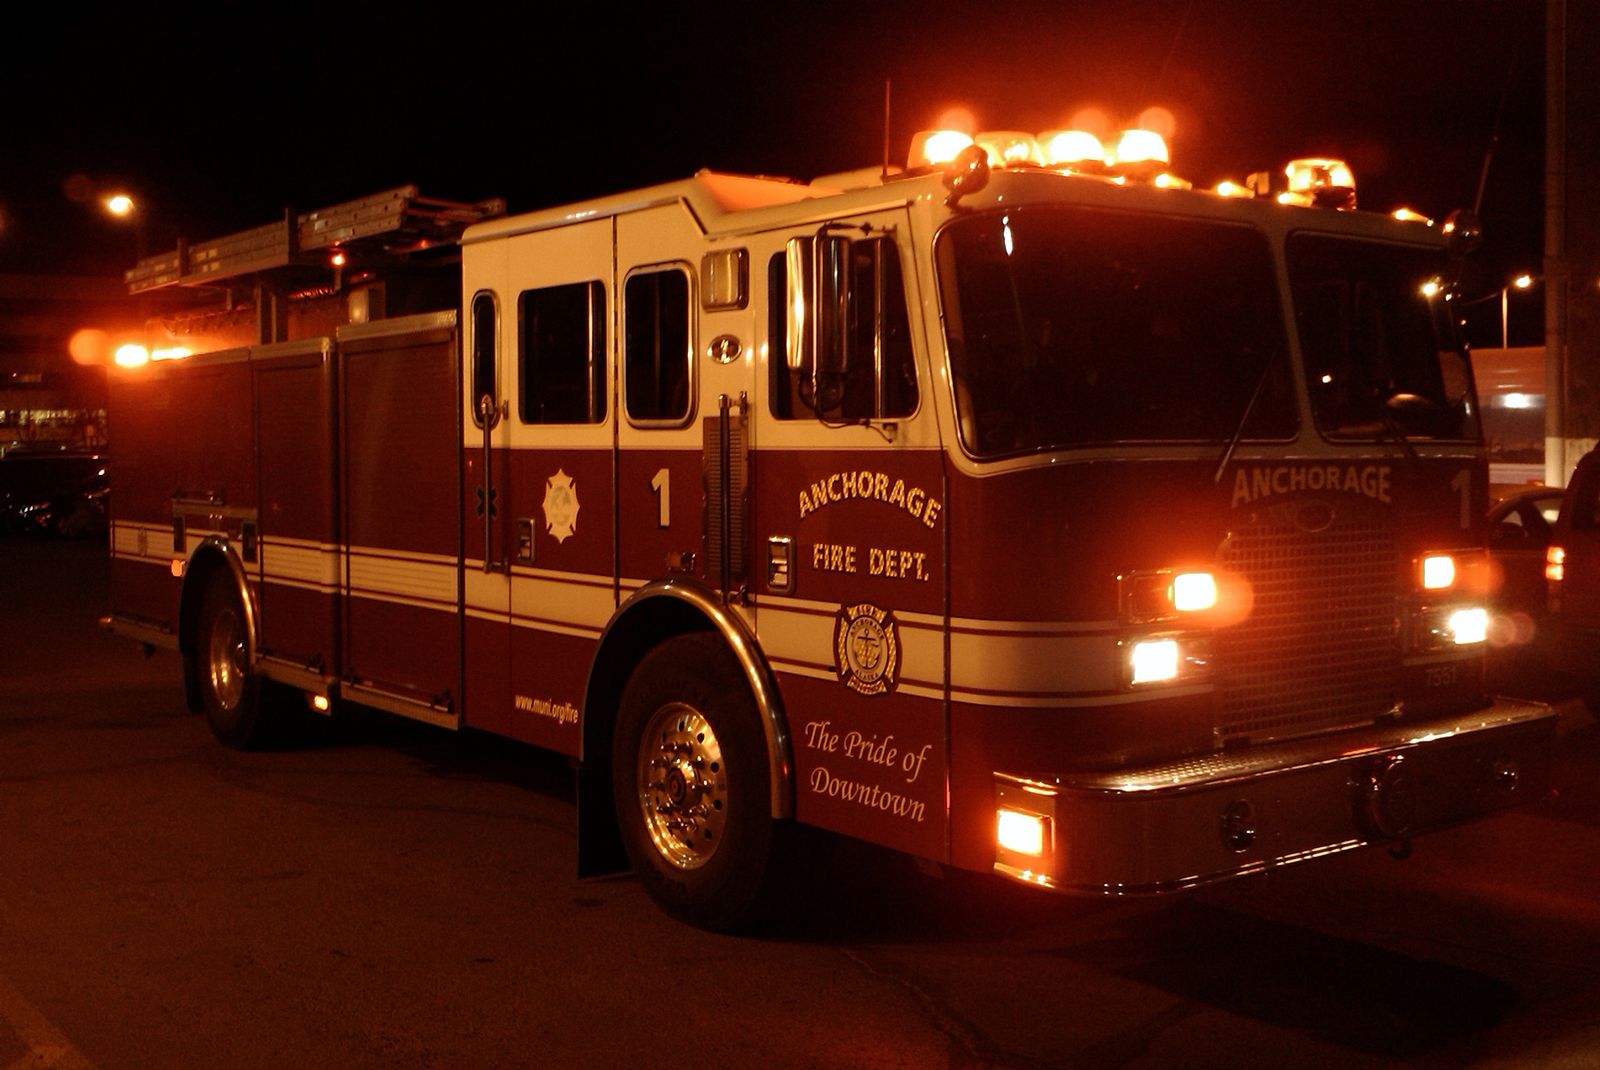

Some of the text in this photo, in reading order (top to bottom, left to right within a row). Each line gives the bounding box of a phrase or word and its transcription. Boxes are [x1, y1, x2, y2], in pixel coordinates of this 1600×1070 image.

[651, 468, 670, 527] 1
[800, 471, 942, 528] ANCHORAGE
[1231, 465, 1392, 508] ANCHORAGE
[1450, 468, 1472, 528] 1
[813, 543, 929, 582] FIRE DEPT.
[849, 618, 885, 641] ANCHORAGE
[805, 721, 932, 782] The Pride of
[810, 767, 926, 822] Downtown
